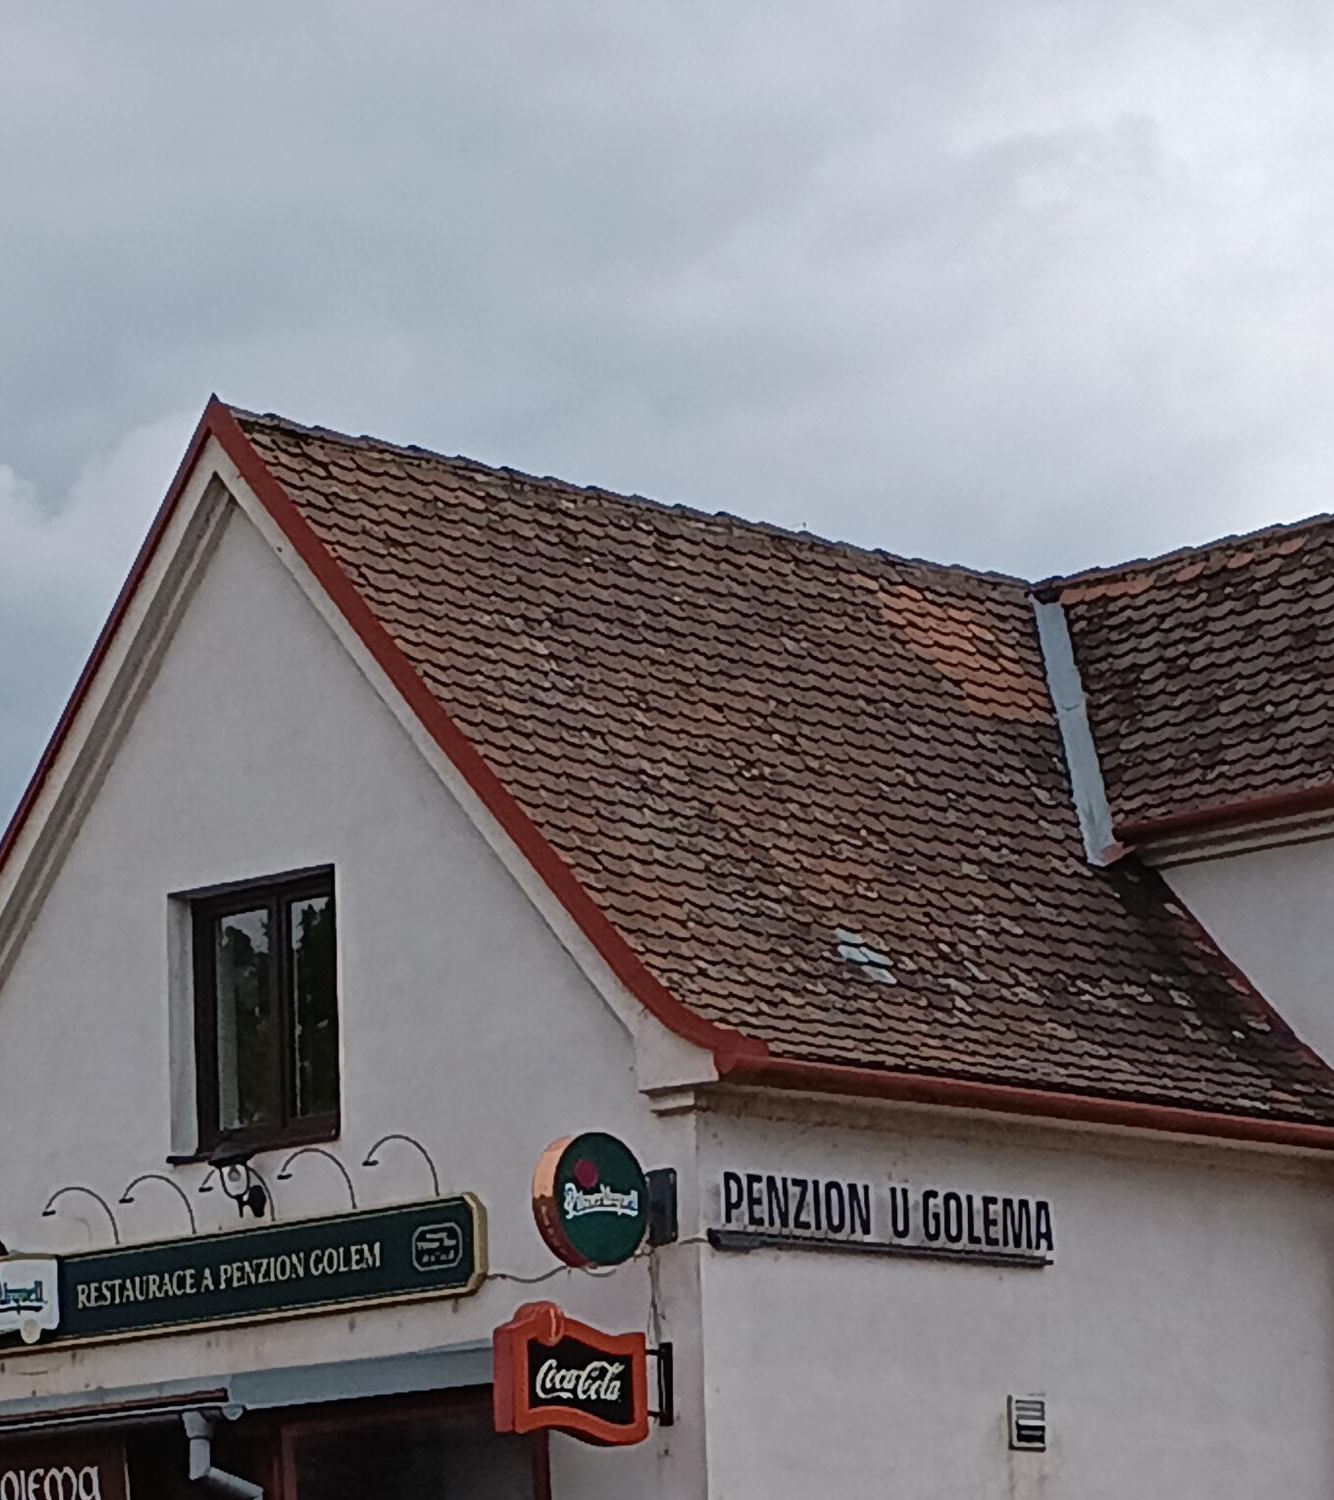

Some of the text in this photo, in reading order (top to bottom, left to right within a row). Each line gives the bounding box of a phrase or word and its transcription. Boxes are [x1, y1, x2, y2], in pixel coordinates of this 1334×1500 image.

[723, 1171, 1054, 1250] PENZION U GOLEMA
[76, 1268, 198, 1310] RESTAURACE
[200, 1267, 215, 1293] A
[219, 1252, 305, 1291] PENZION
[309, 1241, 382, 1277] GOLEM
